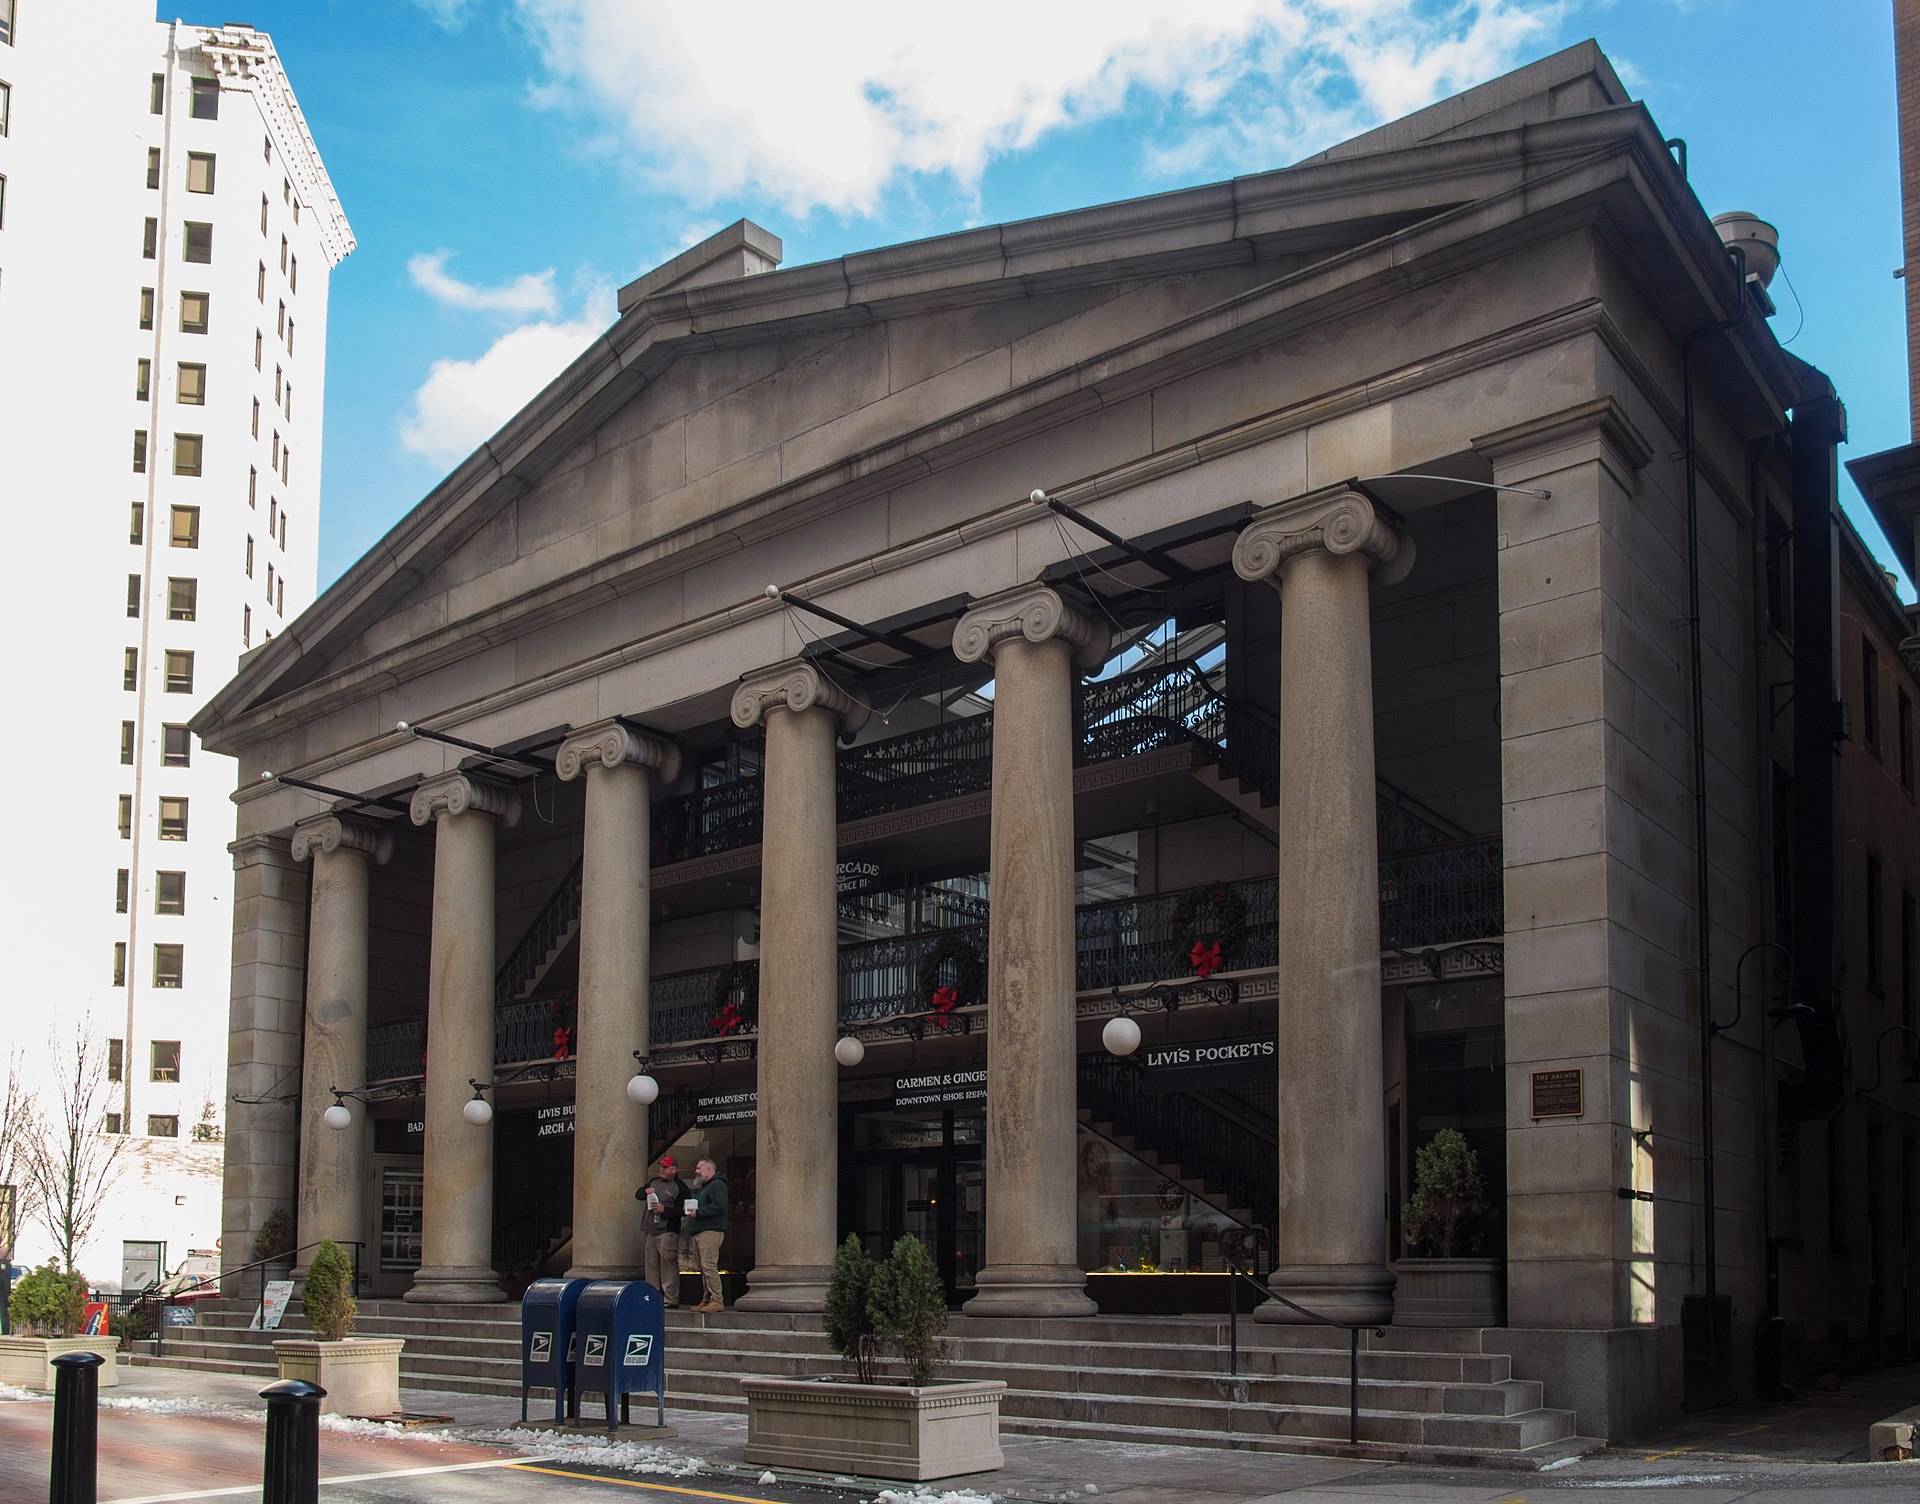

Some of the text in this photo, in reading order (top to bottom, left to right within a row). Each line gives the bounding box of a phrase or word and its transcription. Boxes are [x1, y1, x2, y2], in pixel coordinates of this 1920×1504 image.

[1147, 1041, 1275, 1066] LIVI'S POCKETS
[896, 1070, 987, 1089] CARMEN & GINGE
[1551, 1071, 1577, 1080] ARCADE
[698, 1097, 714, 1106] NEW
[714, 1093, 749, 1105] HARVEST
[895, 1090, 988, 1106] DOWNTOWN SHOE REPA
[538, 1106, 561, 1119] LIVI'S
[696, 1114, 715, 1123] SPLIT
[715, 1111, 736, 1121] APART
[407, 1121, 424, 1133] BAD
[538, 1121, 575, 1136] ARCH A
